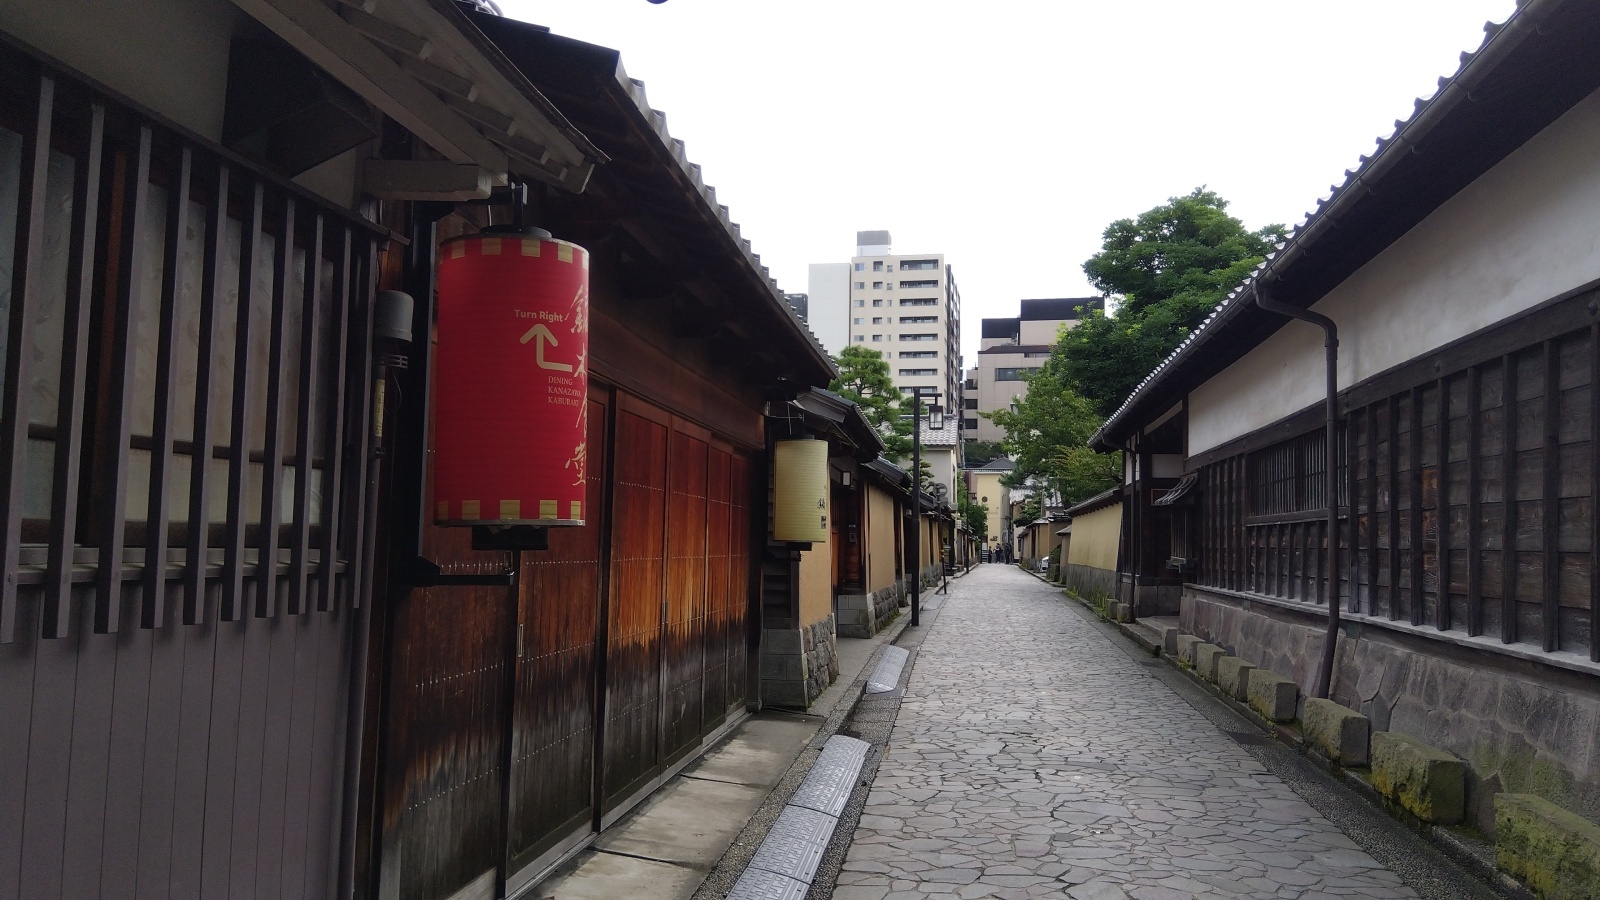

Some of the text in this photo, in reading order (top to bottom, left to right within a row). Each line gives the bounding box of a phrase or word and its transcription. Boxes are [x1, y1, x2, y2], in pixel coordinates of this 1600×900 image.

[514, 309, 563, 323] Turn Right
[548, 375, 573, 386] DINING
[548, 386, 582, 398] KANAZAWA
[548, 396, 579, 407] KABURAKI
